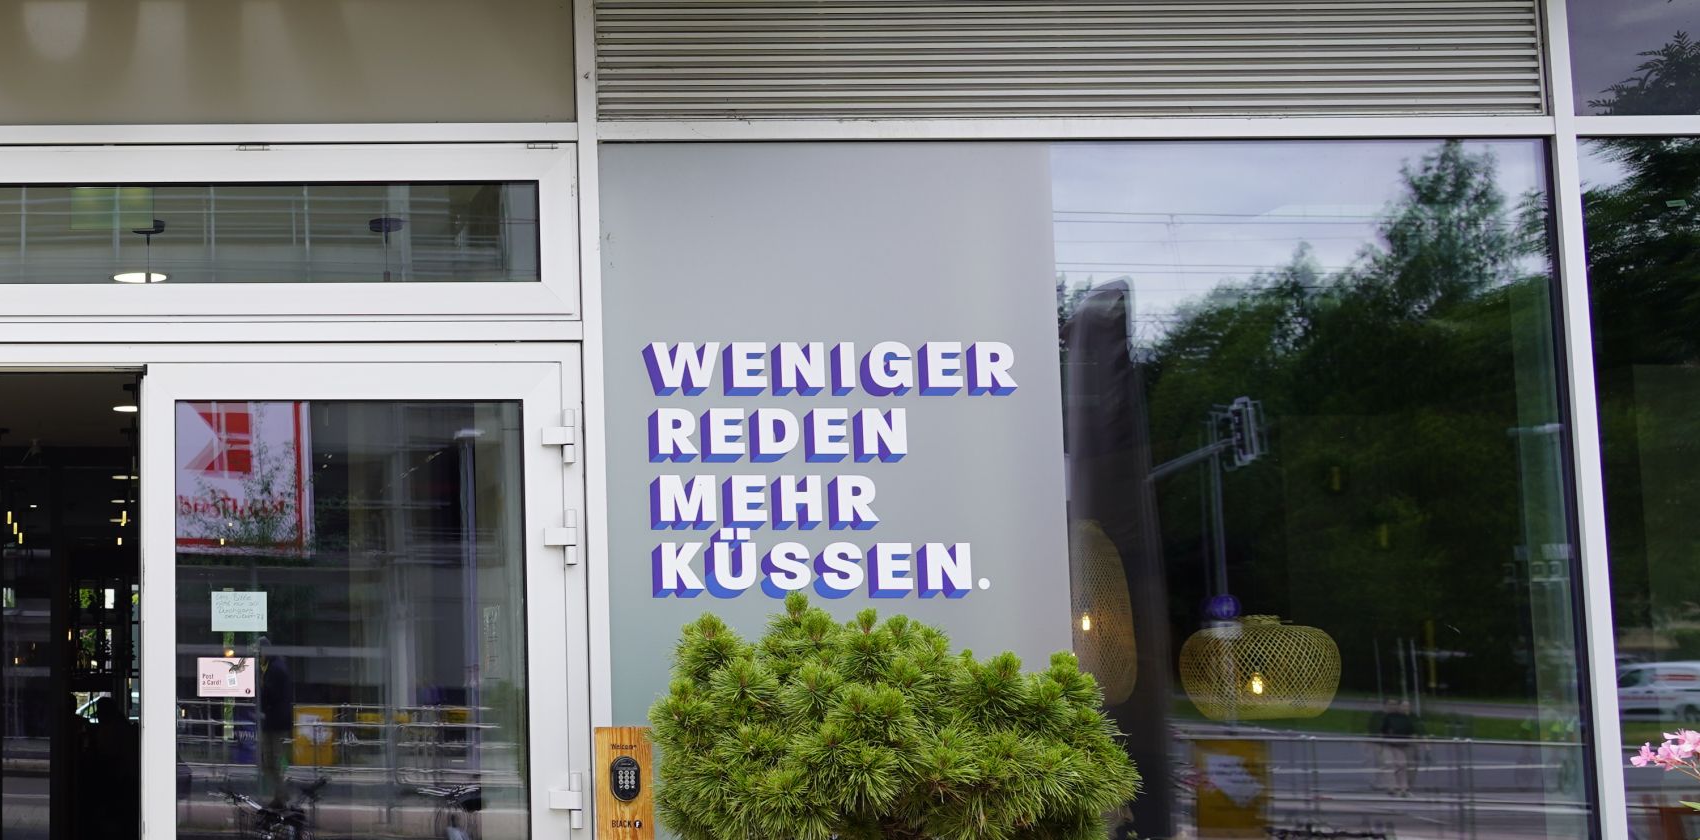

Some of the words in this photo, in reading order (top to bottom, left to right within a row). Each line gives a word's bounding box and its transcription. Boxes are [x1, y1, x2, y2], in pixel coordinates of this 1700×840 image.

[642, 341, 1018, 396] WENIGER
[648, 407, 908, 463] REDEN
[650, 474, 880, 531] MEHR
[651, 527, 991, 599] KÜSSEN.
[611, 820, 632, 828] BLACK
